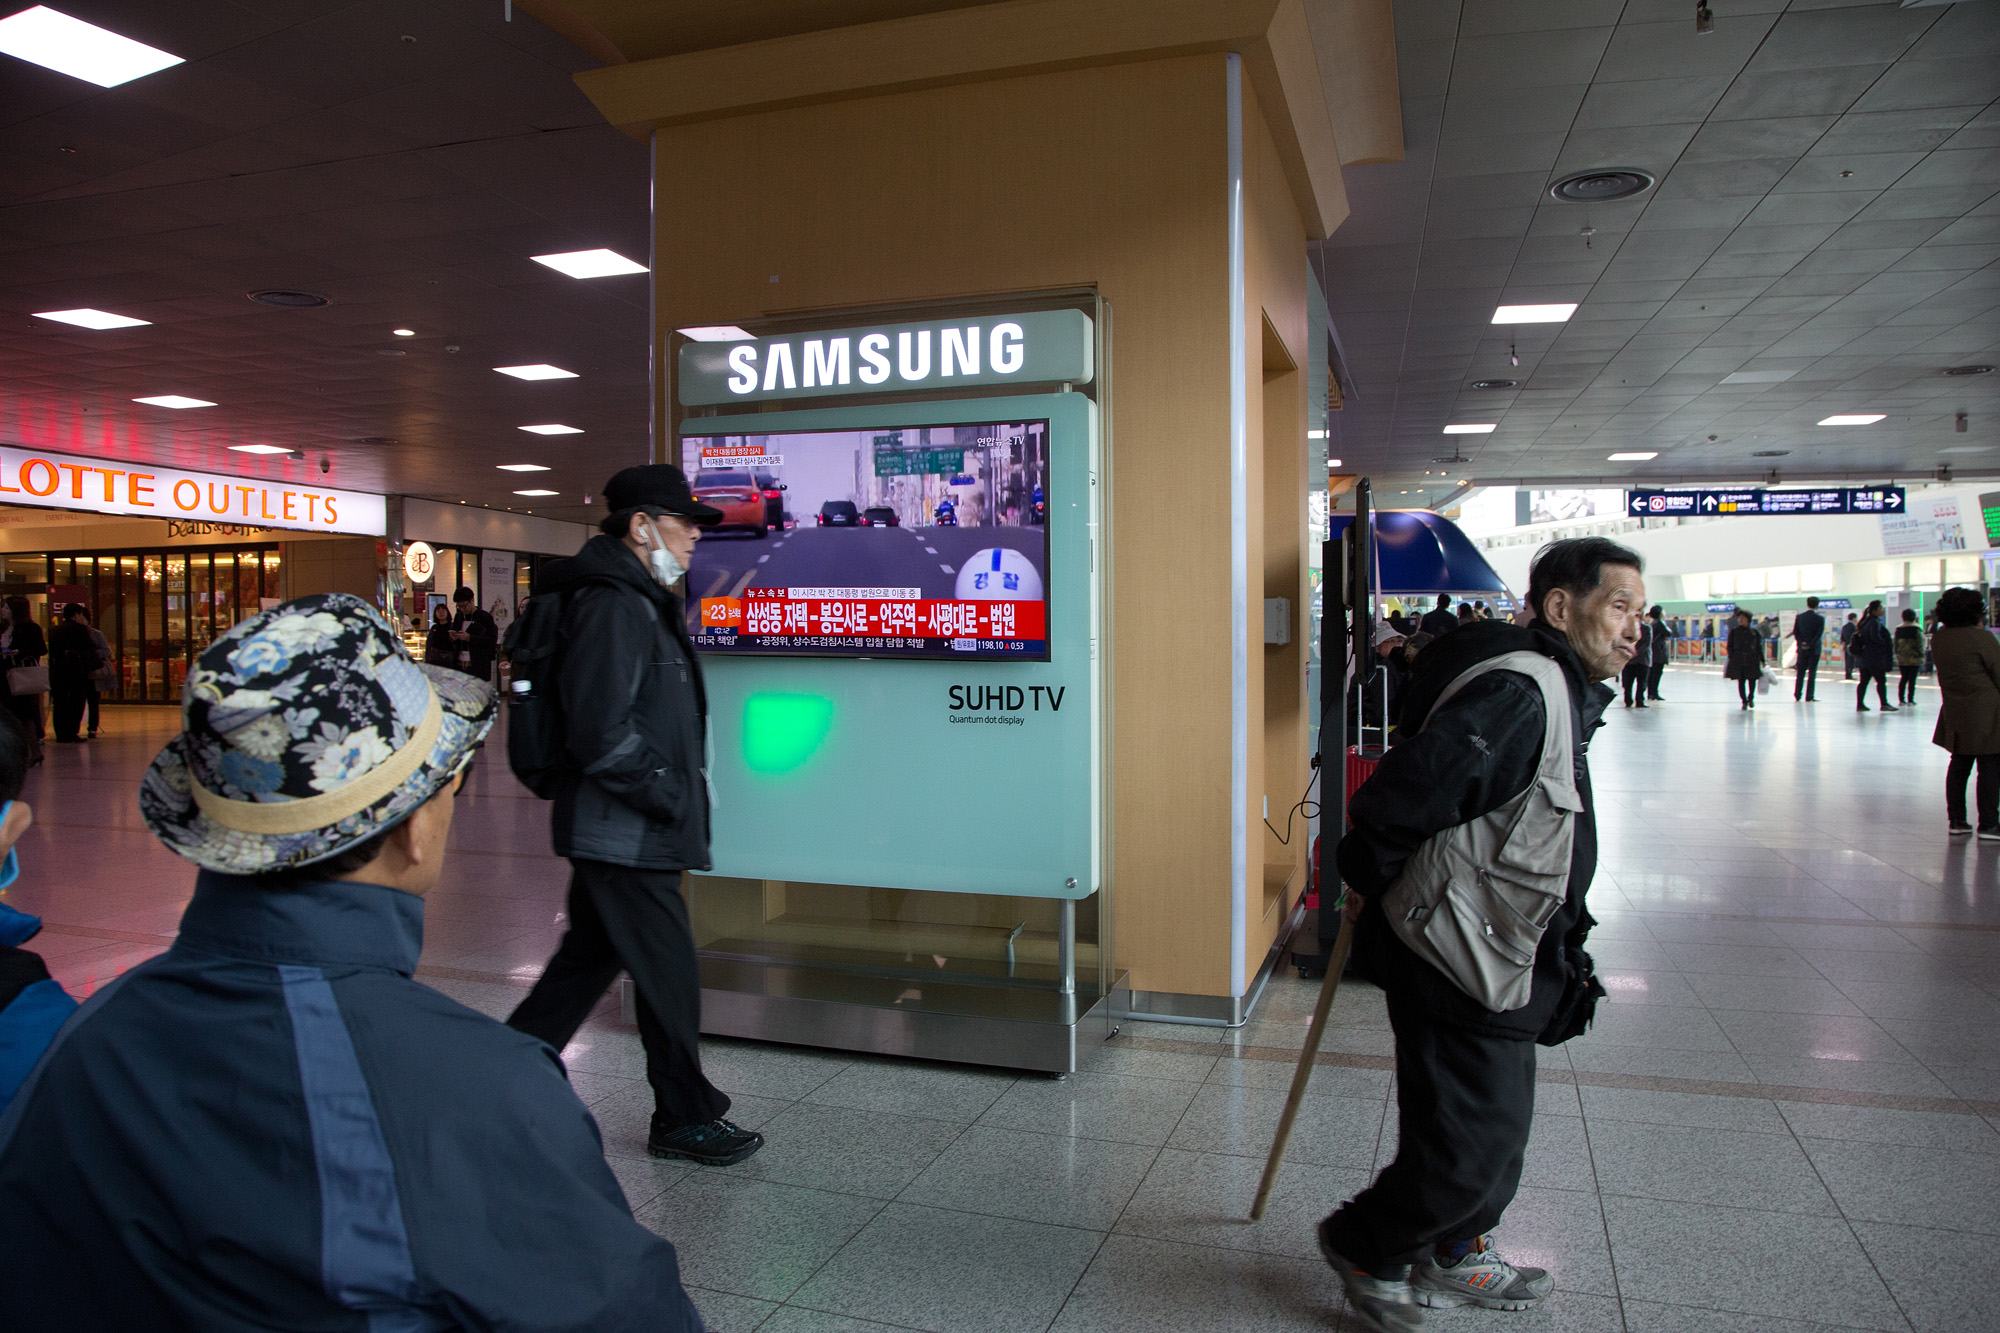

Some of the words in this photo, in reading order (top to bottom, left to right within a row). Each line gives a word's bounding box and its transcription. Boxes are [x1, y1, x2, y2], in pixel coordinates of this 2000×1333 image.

[728, 322, 1024, 395] SAMSUNG
[976, 435, 1025, 447] 연합뉴스TV
[719, 448, 736, 456] 대통령
[706, 457, 724, 466] 이재용
[725, 457, 743, 465] 때보다
[743, 457, 756, 465] 심사
[0, 458, 155, 507] LOTTE
[173, 479, 338, 525] OUTLETS
[747, 588, 785, 598] 뉴스속보
[792, 589, 800, 597] 이
[802, 589, 816, 597] 시각
[818, 589, 825, 597] 박
[827, 589, 835, 597] 전
[837, 589, 858, 598] 대통령
[861, 589, 890, 598] 법원으로
[892, 589, 907, 598] 이동
[909, 589, 916, 598] 중
[710, 604, 727, 621] 23
[746, 601, 782, 634] 삼성동
[784, 601, 808, 634] 자택
[820, 601, 868, 634] 봉은사로
[879, 602, 916, 635] 언주역
[928, 602, 978, 636] 사평대로
[990, 603, 1015, 637] 법원
[698, 635, 715, 646] 미국
[762, 636, 791, 647] 공정위,
[793, 636, 863, 648] 상수도검침시스템
[865, 637, 883, 648] 입찰
[885, 638, 904, 648] 담합
[906, 638, 925, 649] 적발
[977, 640, 1004, 650] 1198.10
[1010, 642, 1024, 650] 0.53
[948, 685, 1025, 711] SUHD
[1028, 686, 1065, 711] TV
[949, 715, 984, 724] Quantum
[984, 715, 997, 724] dot
[998, 715, 1025, 726] display
